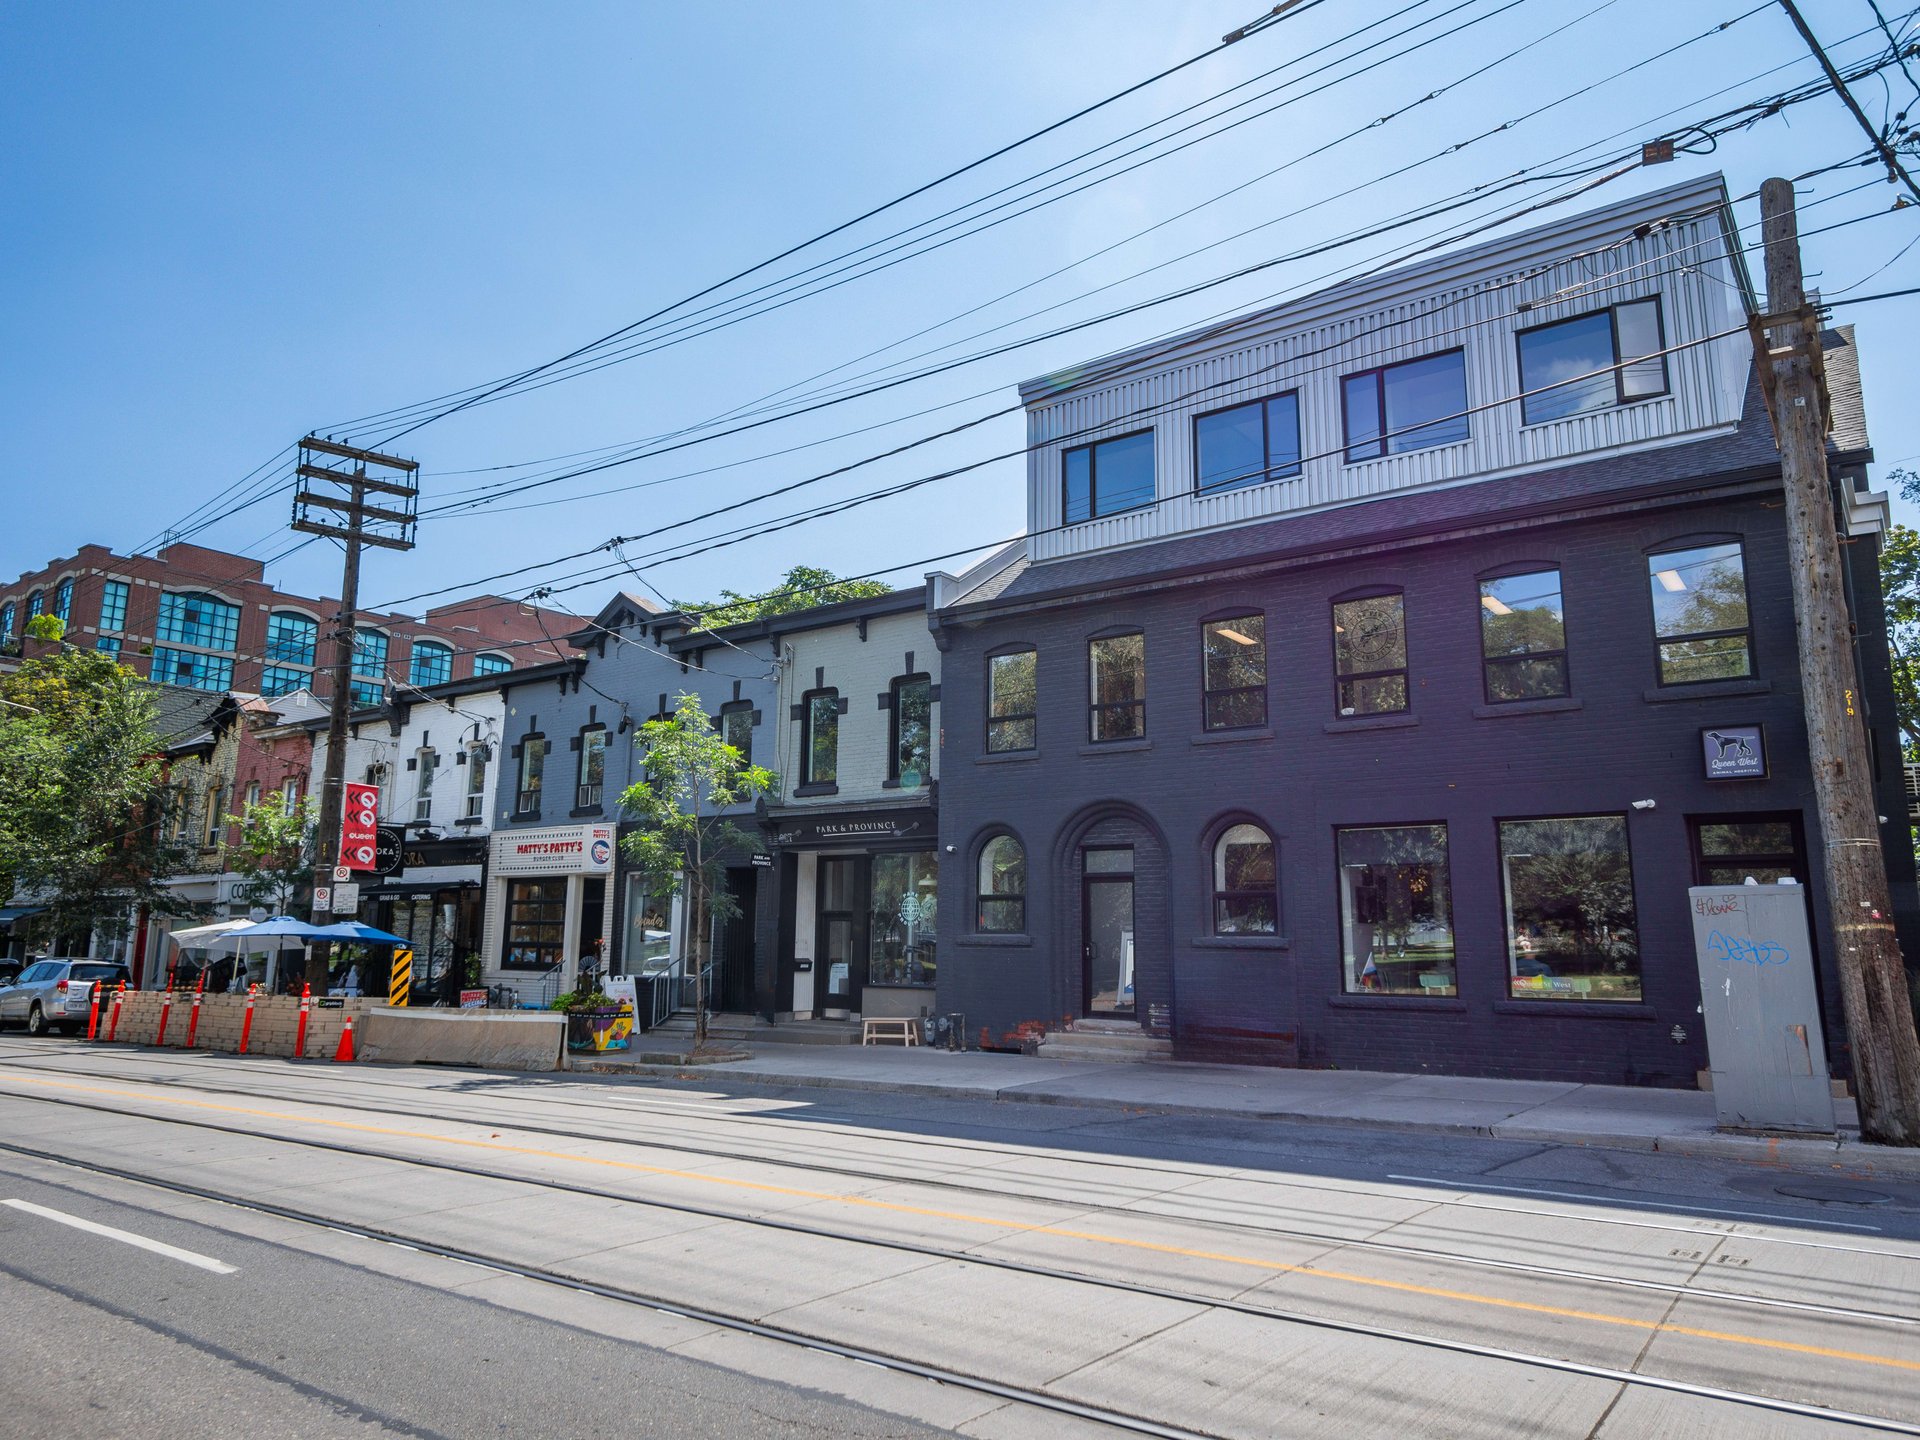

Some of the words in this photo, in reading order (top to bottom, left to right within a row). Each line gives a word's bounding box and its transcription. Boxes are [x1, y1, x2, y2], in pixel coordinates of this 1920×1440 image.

[1845, 690, 1854, 716] 219
[1711, 759, 1736, 769] Queen
[1738, 757, 1758, 766] West
[816, 825, 838, 833] PARK
[840, 824, 846, 832] &
[849, 821, 896, 831] PROVINCE
[517, 842, 548, 854] MATTY'S
[550, 841, 583, 853] PATTY'S
[1552, 980, 1571, 988] West
